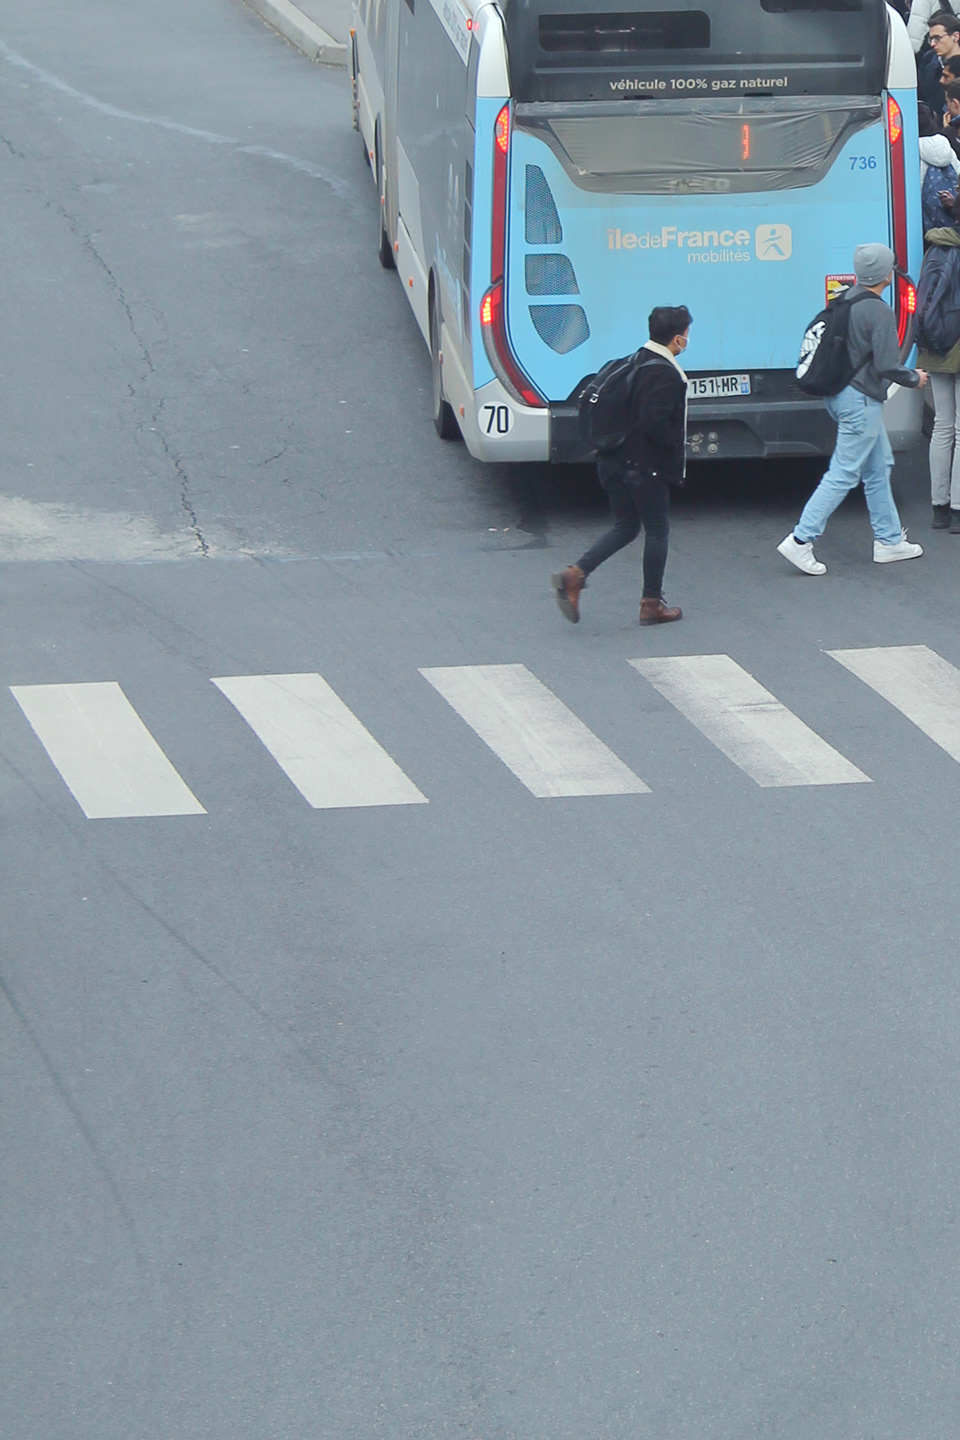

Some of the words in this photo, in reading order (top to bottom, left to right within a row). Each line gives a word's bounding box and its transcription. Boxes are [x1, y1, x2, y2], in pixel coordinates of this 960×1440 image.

[609, 78, 667, 91] véhicule
[670, 78, 708, 90] 100%
[711, 79, 737, 91] gaz
[739, 76, 788, 88] naturel
[849, 155, 877, 170] 736
[687, 249, 751, 263] mobilités
[483, 405, 509, 434] 70
